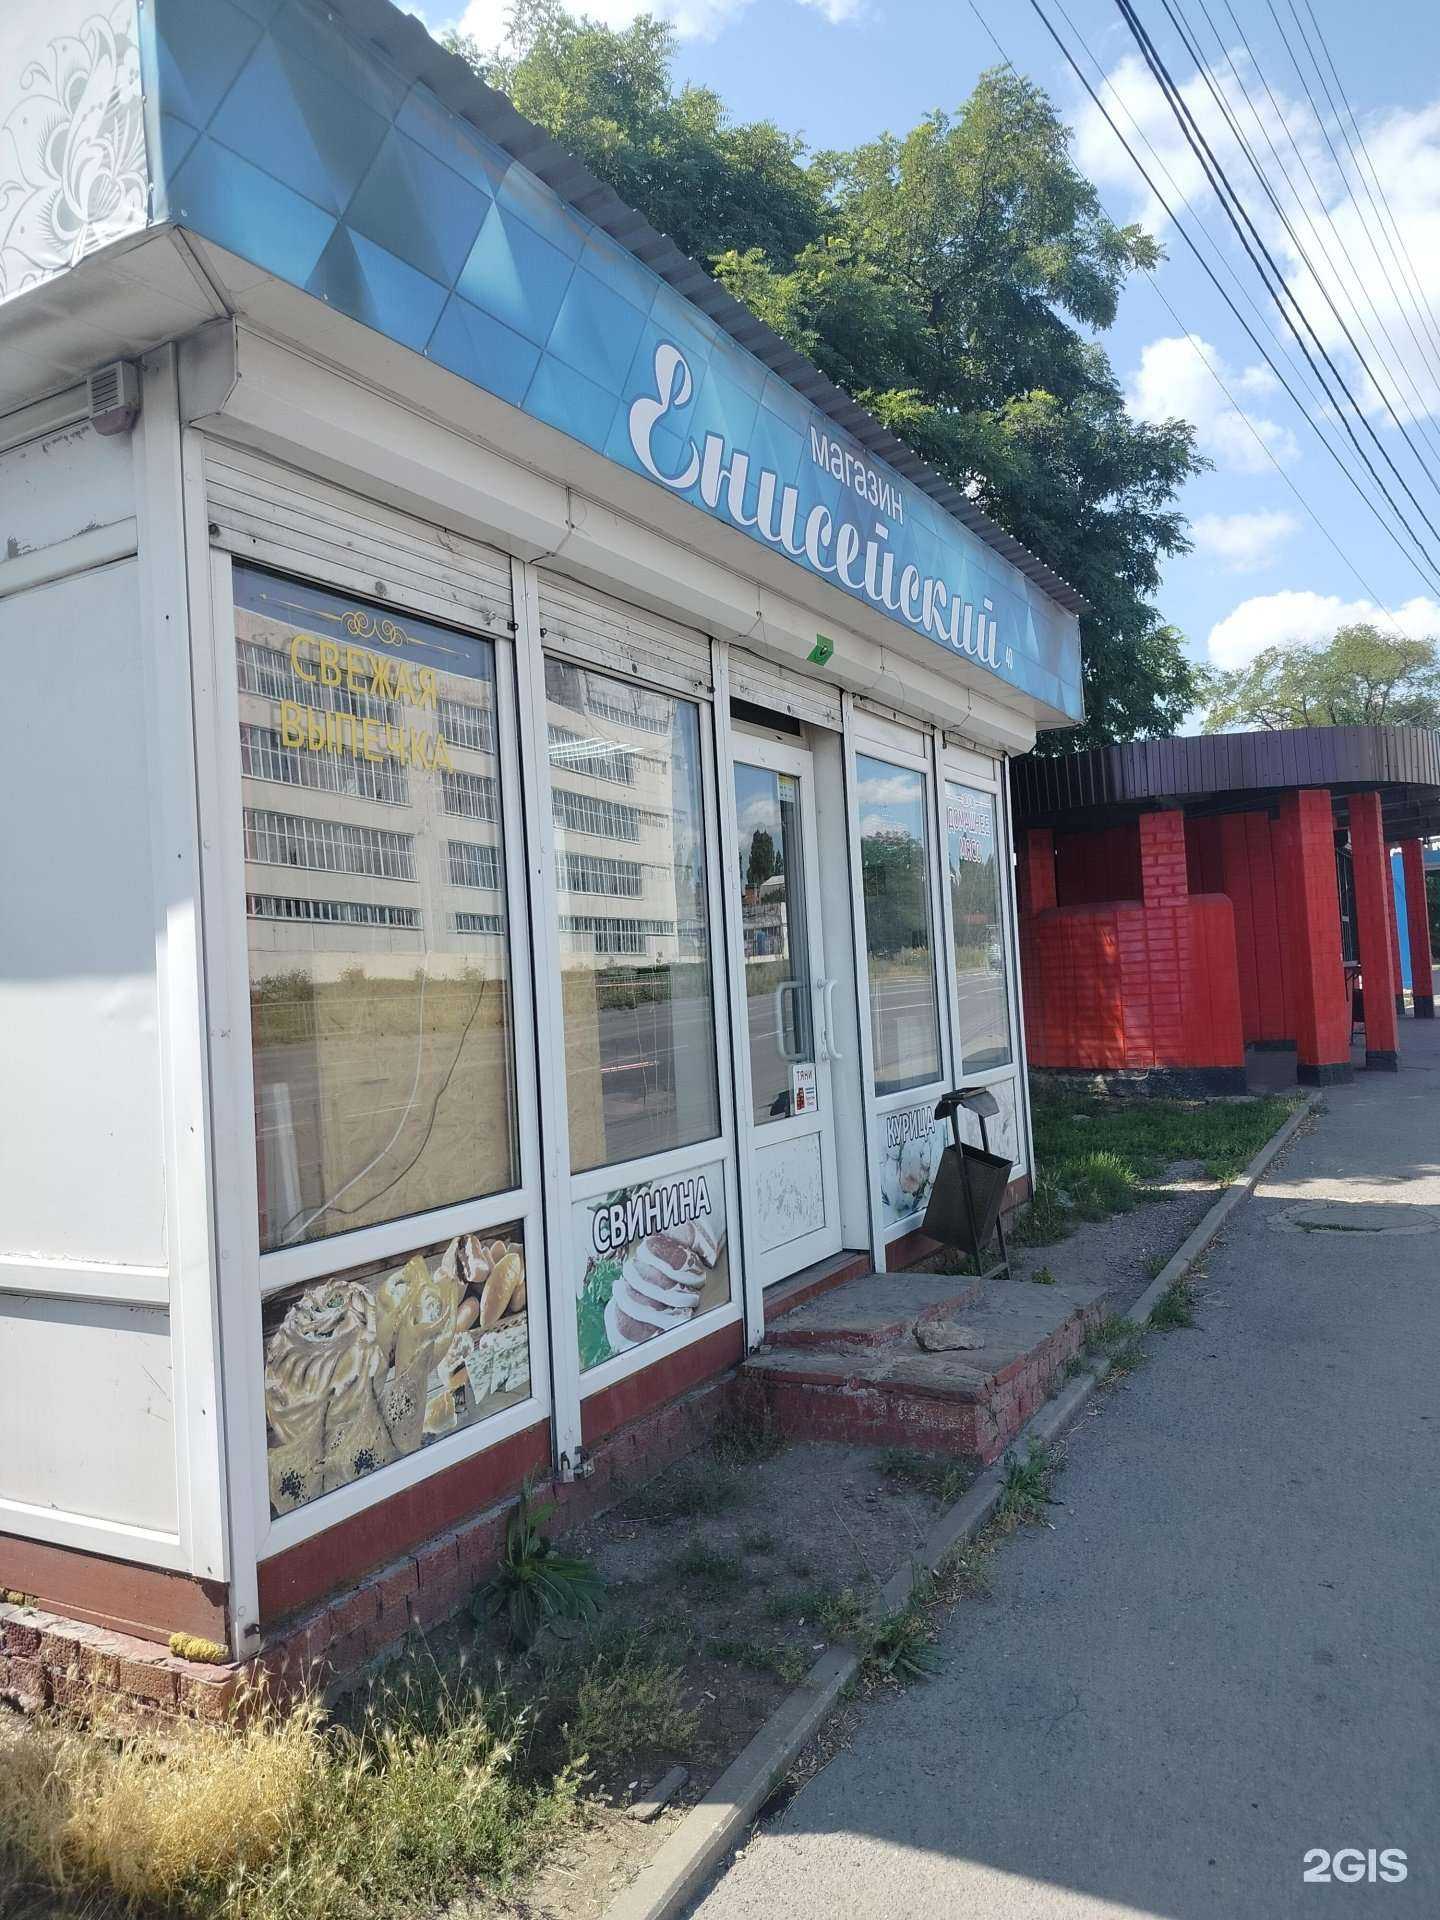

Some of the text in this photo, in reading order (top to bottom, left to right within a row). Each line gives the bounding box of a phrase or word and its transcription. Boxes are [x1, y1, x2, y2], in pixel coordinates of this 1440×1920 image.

[630, 344, 1001, 669] Енисейский
[809, 425, 904, 525] магазин
[291, 635, 439, 709] СВЕЖАЯ
[281, 701, 453, 772] ВЫПЕЧКА
[886, 1106, 936, 1148] КУРИЦА
[593, 1175, 711, 1254] СВИНИНА
